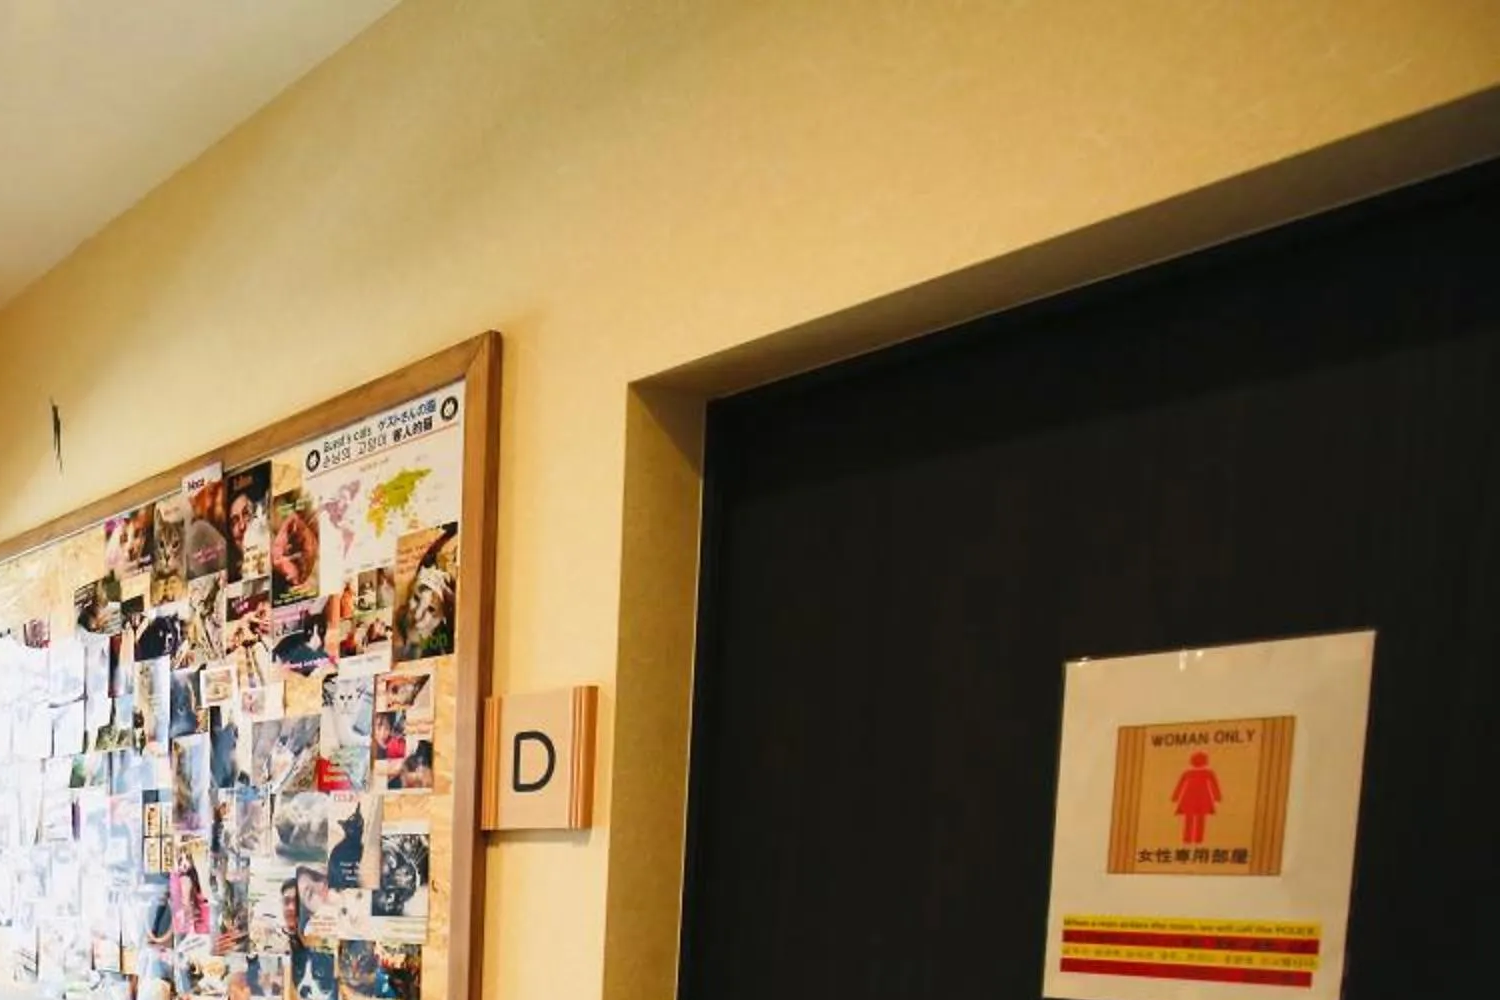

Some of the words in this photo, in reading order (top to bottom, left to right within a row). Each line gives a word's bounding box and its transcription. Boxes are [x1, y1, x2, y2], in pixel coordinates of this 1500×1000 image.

[1151, 731, 1209, 747] WOMAN
[1213, 728, 1256, 745] ONLY
[513, 731, 557, 793] D
